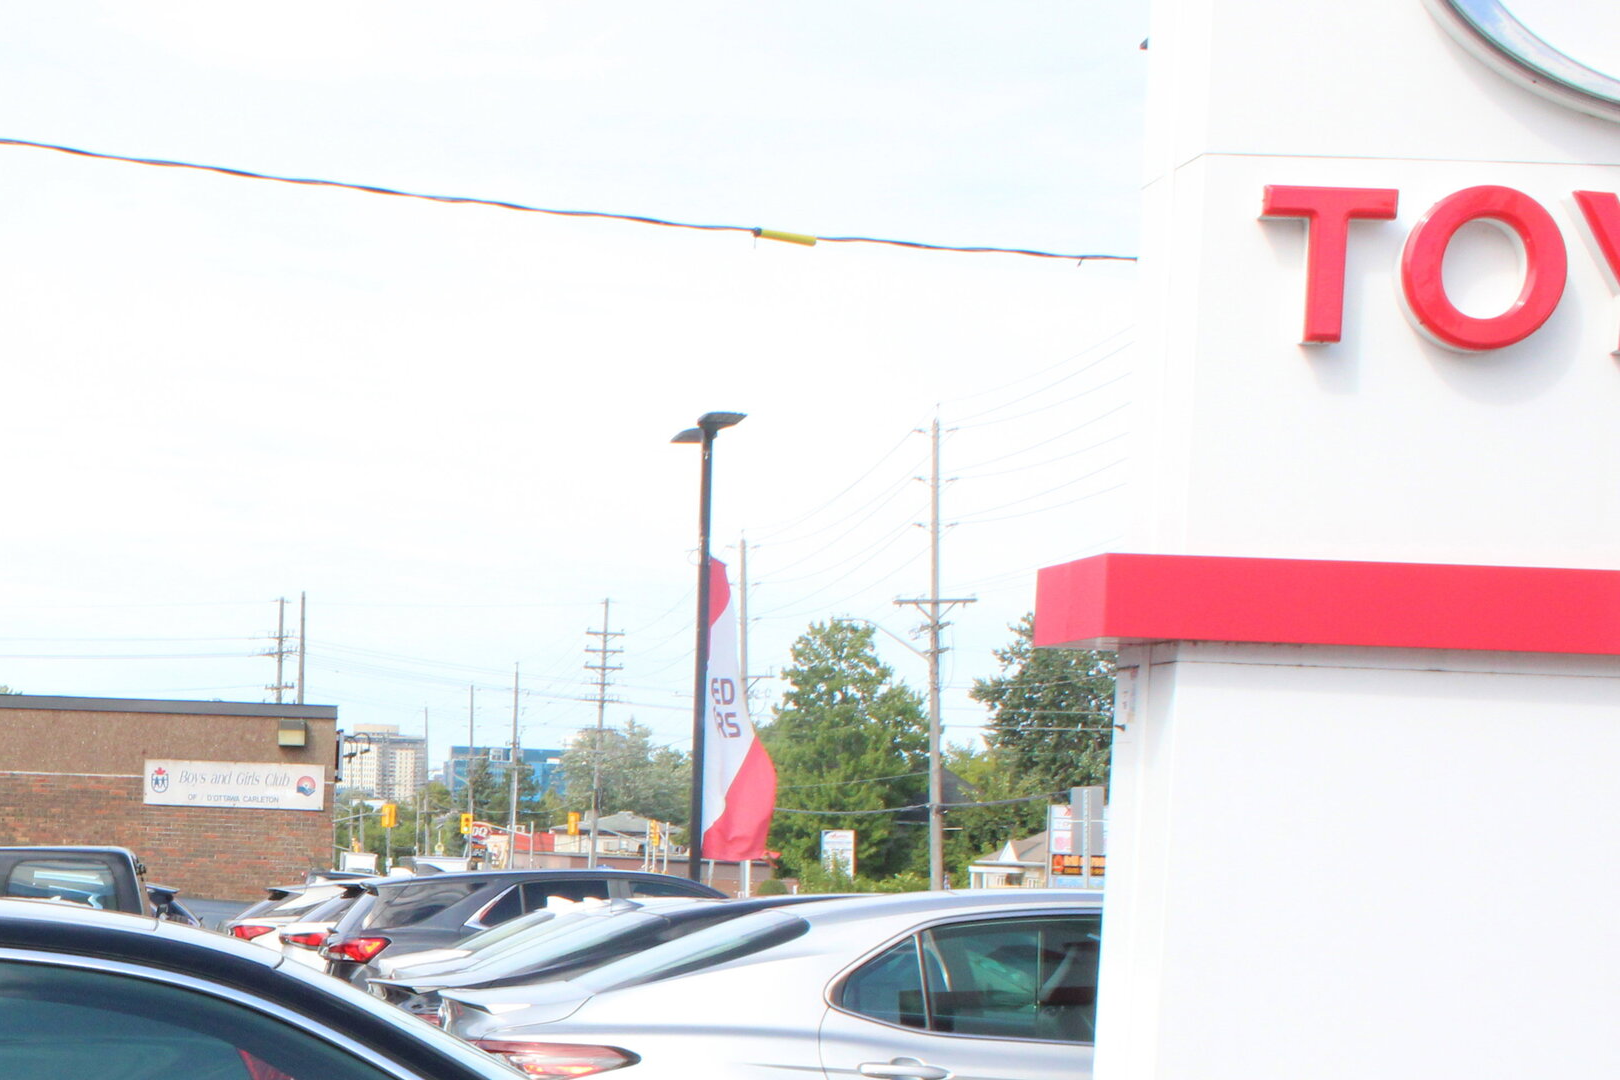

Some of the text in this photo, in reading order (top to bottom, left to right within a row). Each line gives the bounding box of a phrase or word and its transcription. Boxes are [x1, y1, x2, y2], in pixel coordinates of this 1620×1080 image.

[179, 769, 290, 788] Boys and Girls Club
[187, 793, 197, 801] OF
[243, 795, 279, 804] CARLETON
